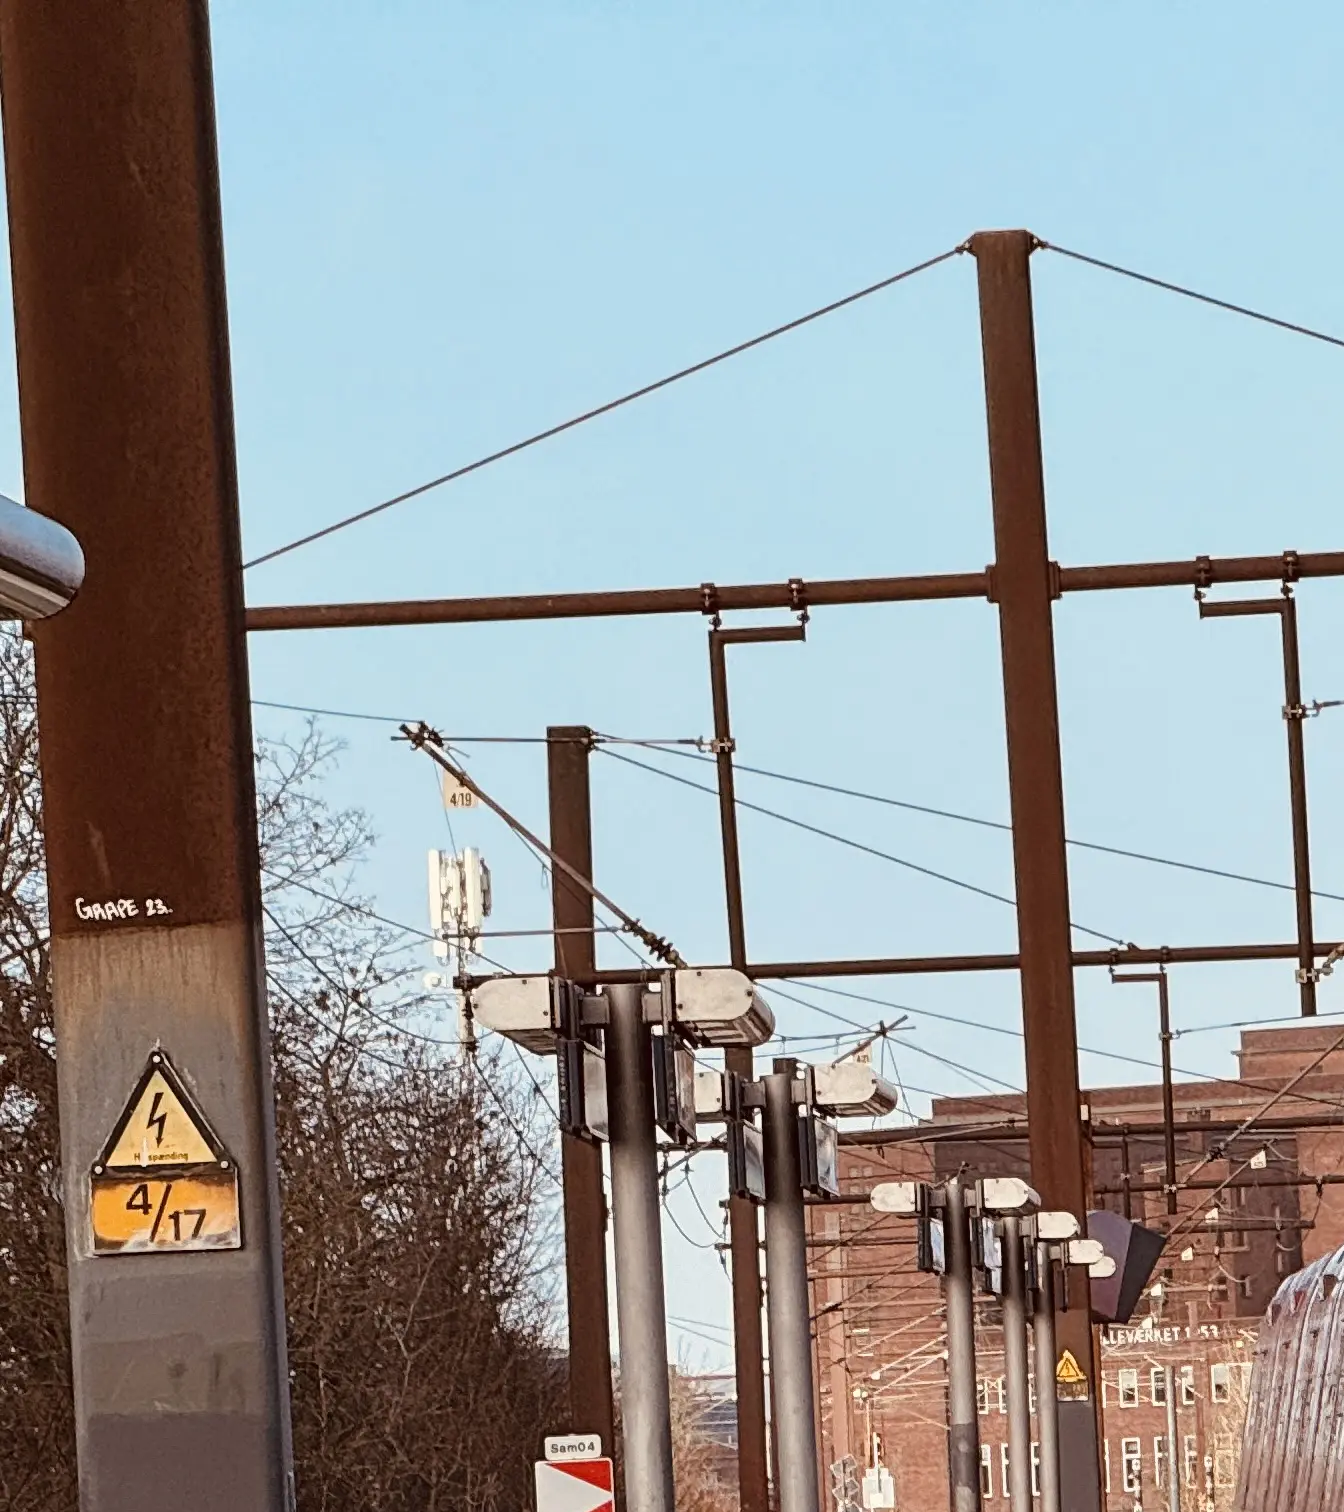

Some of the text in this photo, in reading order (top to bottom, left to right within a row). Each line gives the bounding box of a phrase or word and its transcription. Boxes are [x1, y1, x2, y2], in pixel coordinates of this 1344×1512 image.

[450, 792, 472, 807] 4/19
[133, 1151, 189, 1163] Hspænding
[1184, 1324, 1219, 1341] 153
[550, 1441, 596, 1454] Sam04
